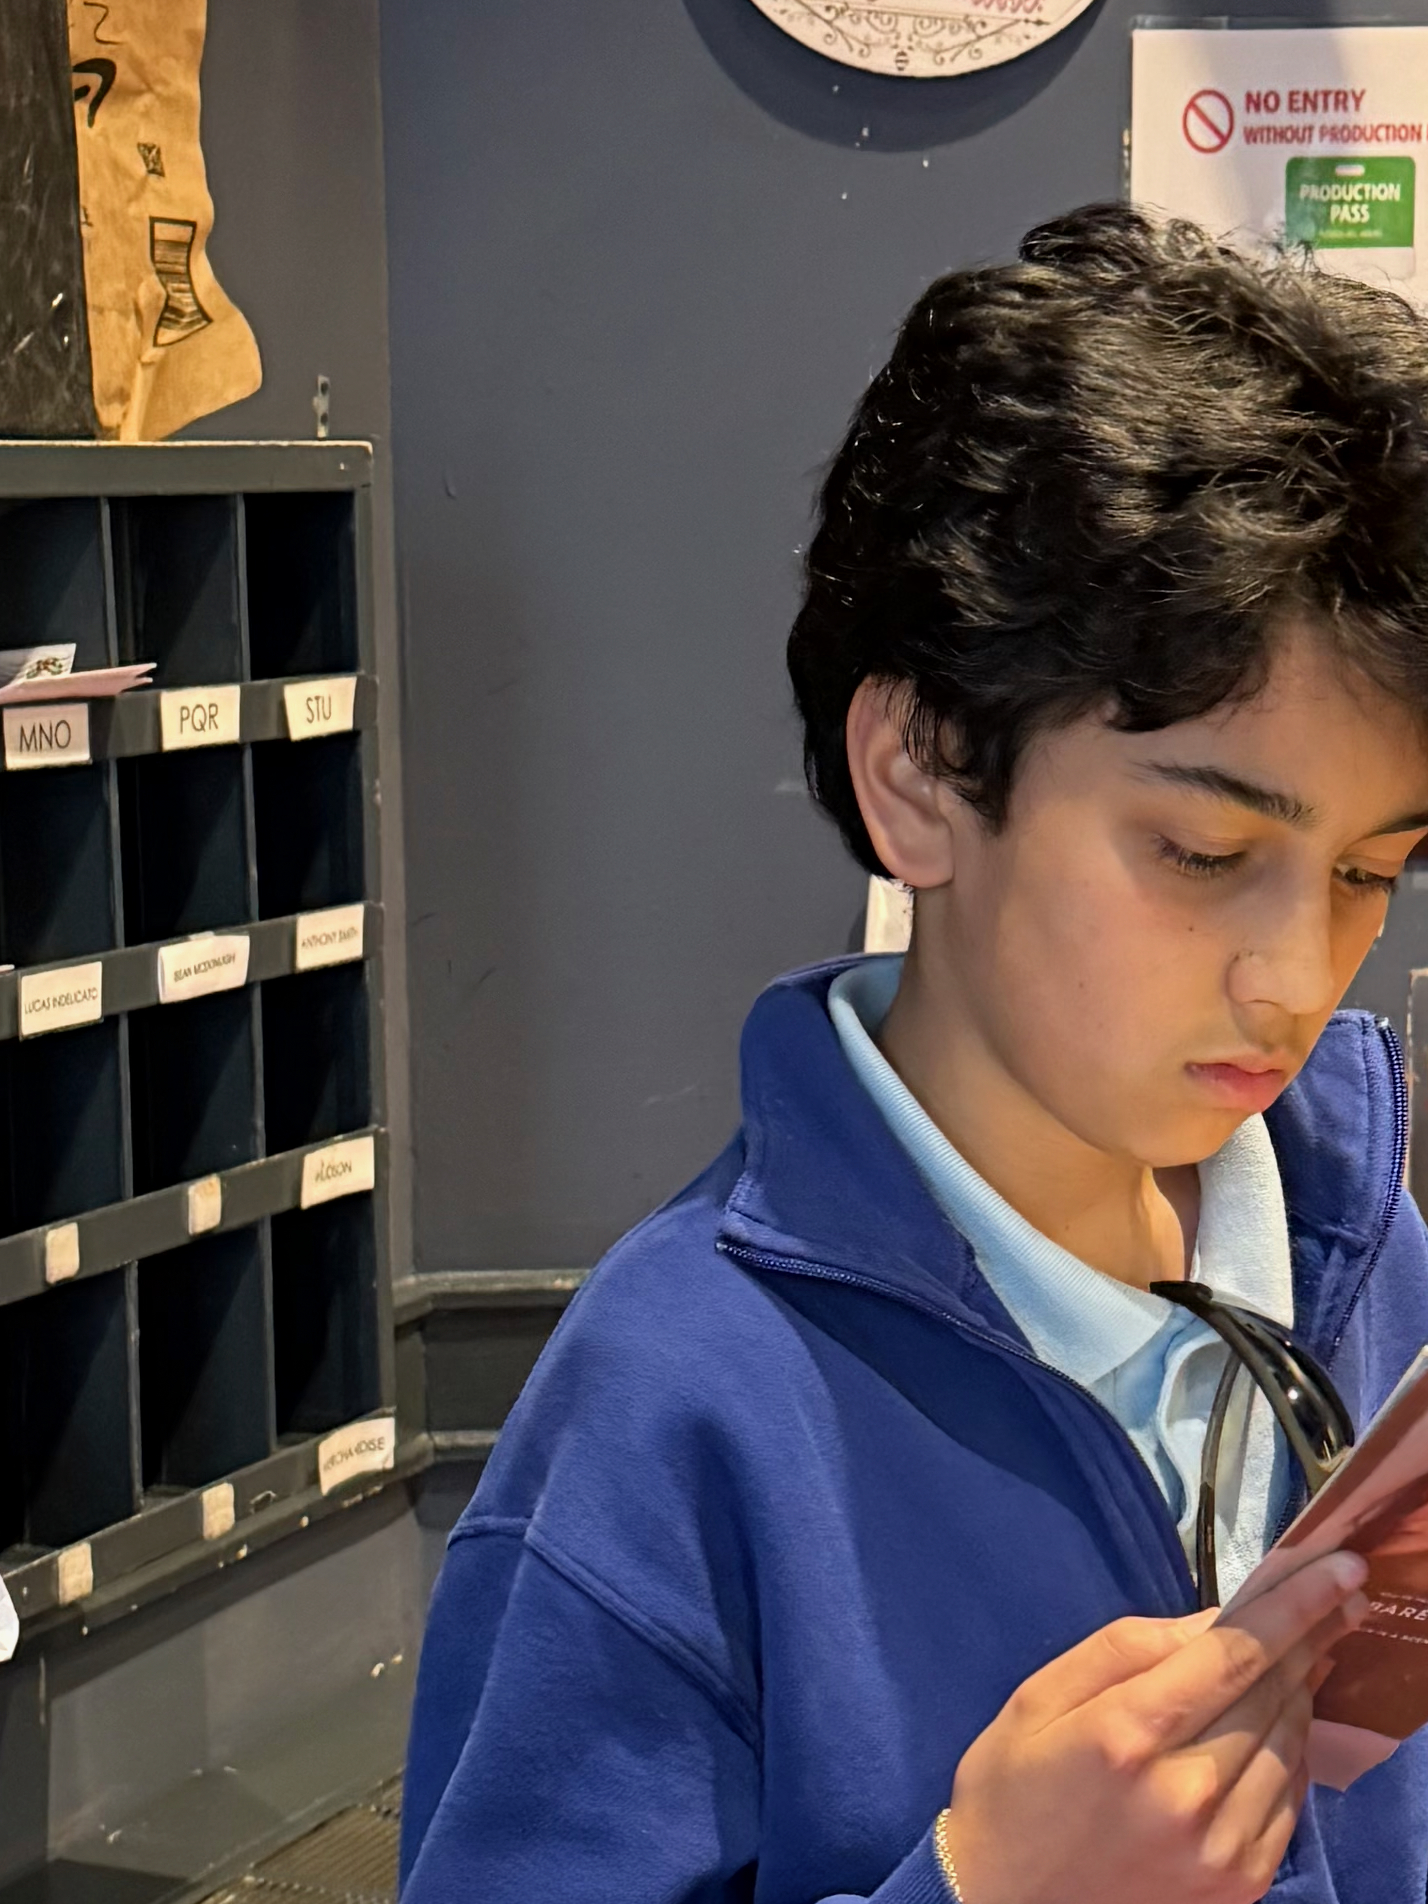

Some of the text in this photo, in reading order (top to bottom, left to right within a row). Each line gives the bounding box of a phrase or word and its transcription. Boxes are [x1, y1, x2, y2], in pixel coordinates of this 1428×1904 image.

[1244, 89, 1366, 113] NO ENTRY
[1243, 124, 1314, 145] WITHOUT
[1319, 123, 1422, 143] PRODUCTION
[1299, 183, 1401, 202] PRODUCTION
[1330, 203, 1370, 223] PASS
[180, 703, 220, 734] PQR
[305, 695, 332, 724] STU
[19, 719, 72, 753] MNO
